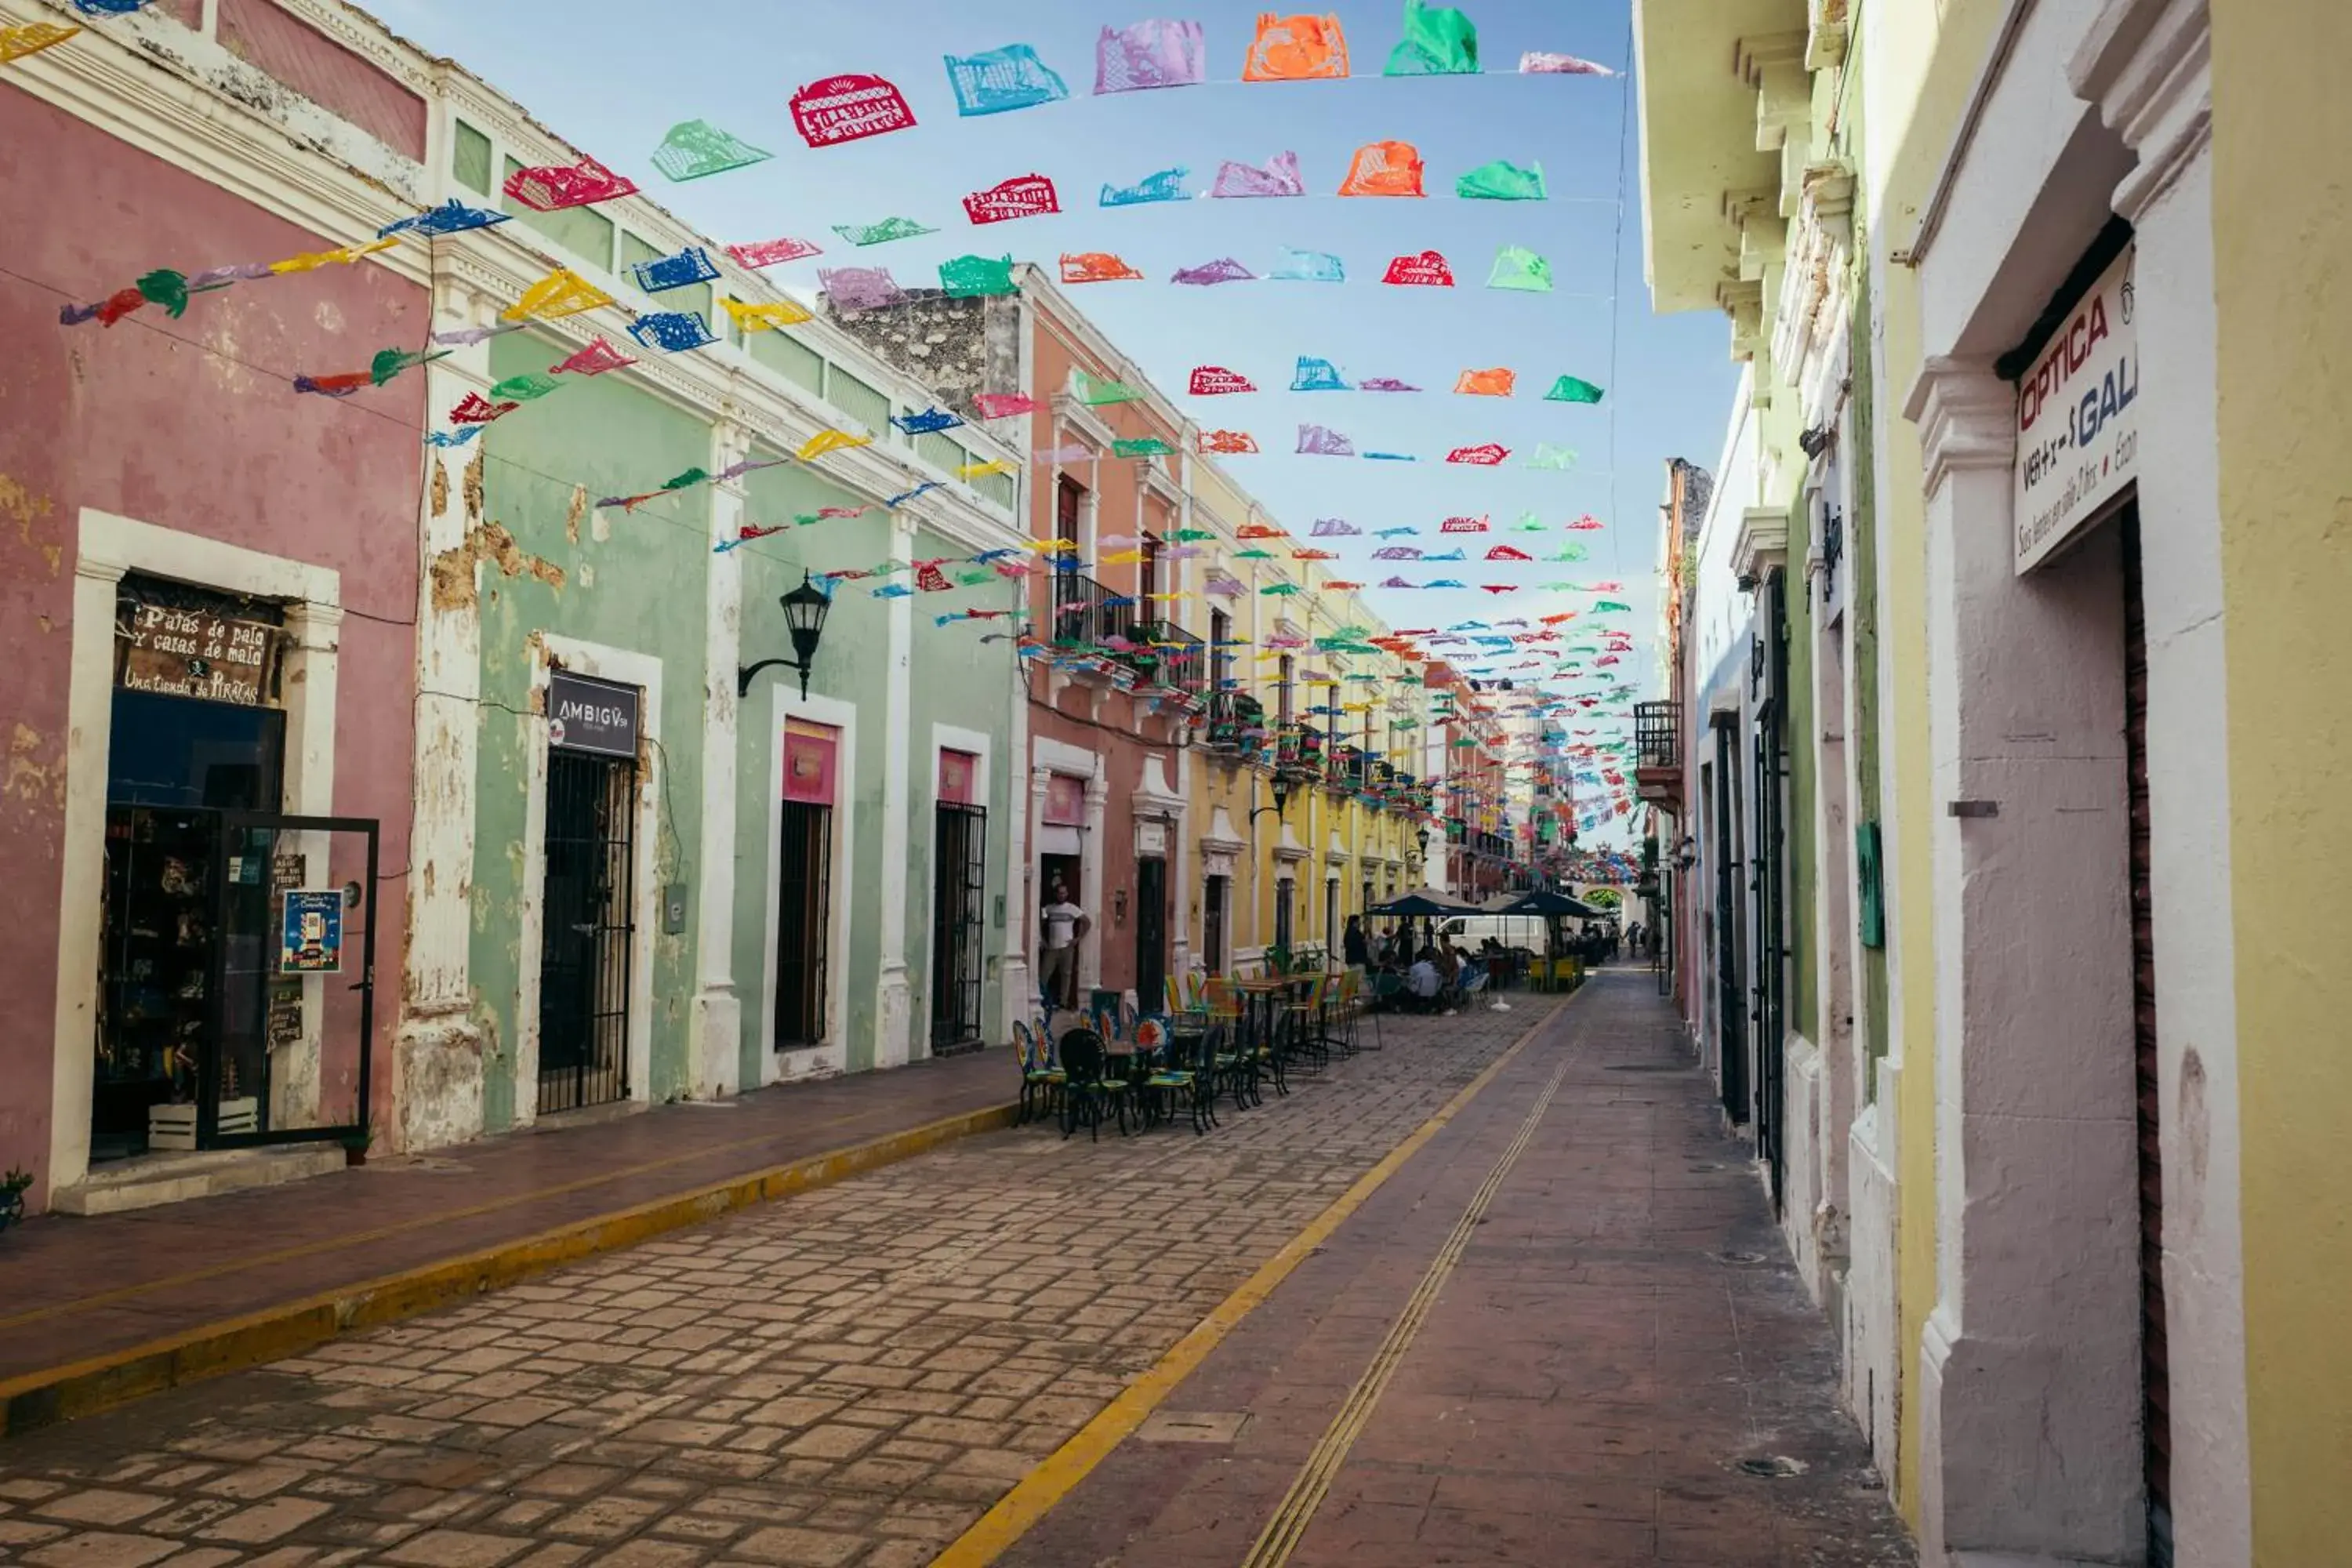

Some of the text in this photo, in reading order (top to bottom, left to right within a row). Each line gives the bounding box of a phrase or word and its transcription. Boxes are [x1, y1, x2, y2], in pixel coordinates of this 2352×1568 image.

[2021, 294, 2108, 430] OPTICA
[2078, 343, 2137, 448] GAL
[144, 609, 265, 646] Patas de palo
[153, 633, 196, 655] caras
[205, 640, 222, 659] de
[227, 647, 262, 666] malo
[125, 665, 151, 690] Una
[154, 674, 191, 695] tienda
[195, 681, 209, 698] de
